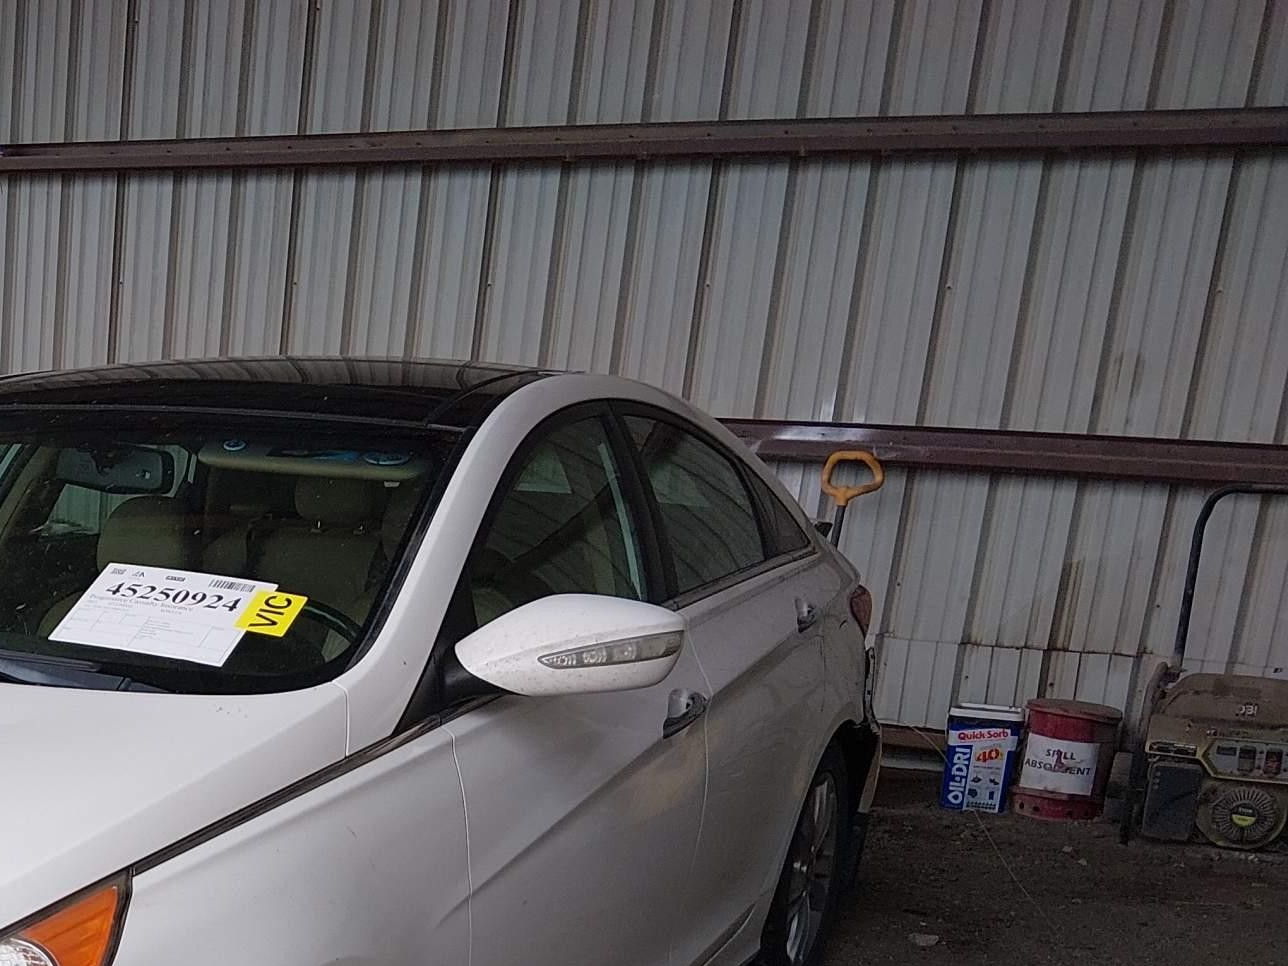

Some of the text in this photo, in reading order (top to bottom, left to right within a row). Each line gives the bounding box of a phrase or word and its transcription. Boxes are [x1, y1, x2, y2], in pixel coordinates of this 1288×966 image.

[105, 582, 242, 612] 45250924
[248, 596, 292, 627] VIC
[1024, 758, 1091, 776] ABSOENT
